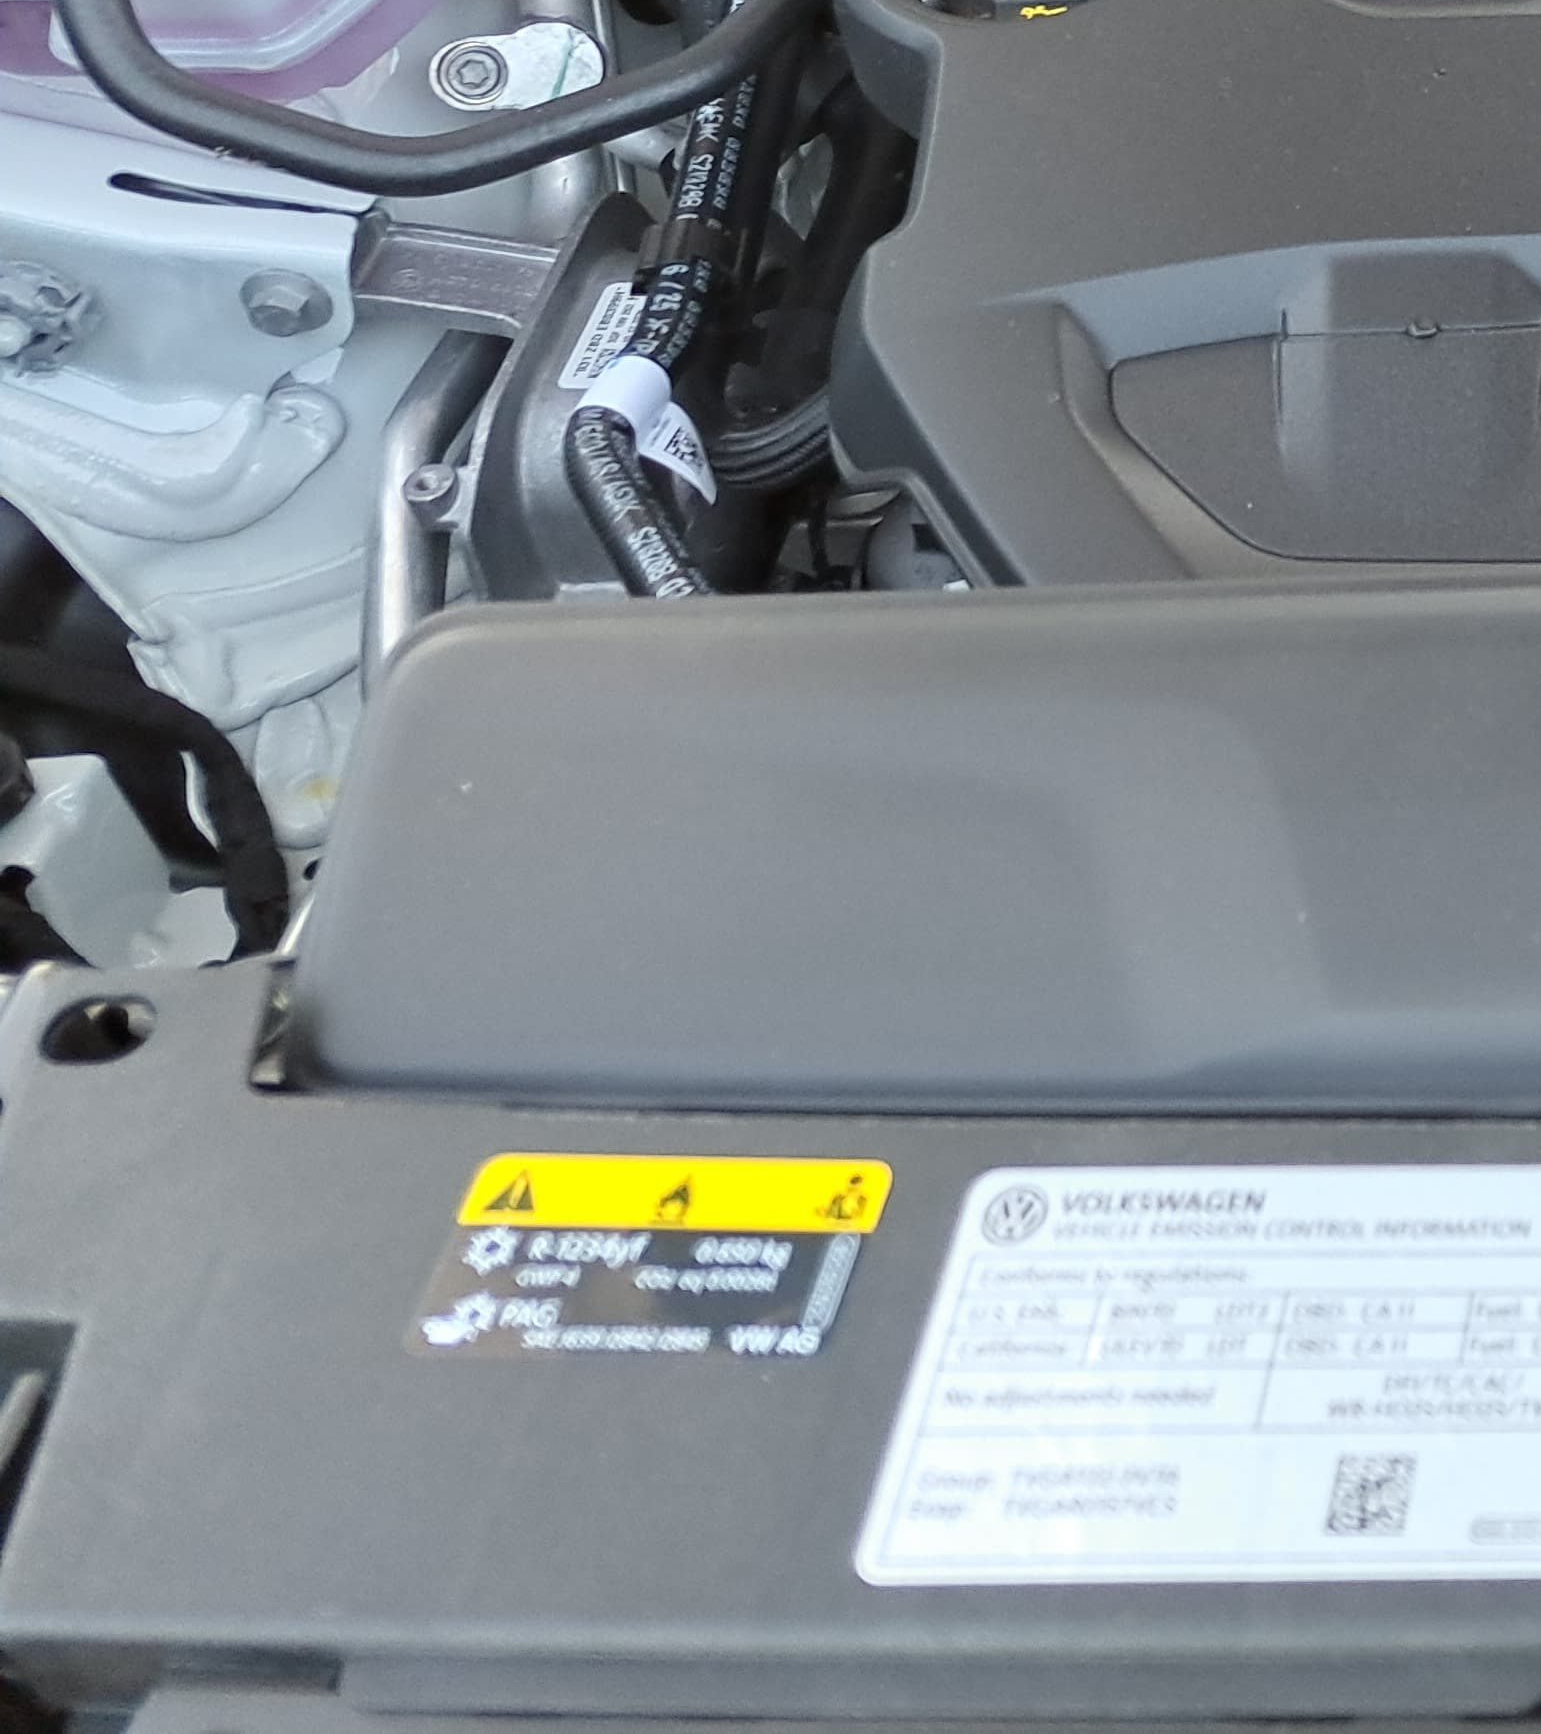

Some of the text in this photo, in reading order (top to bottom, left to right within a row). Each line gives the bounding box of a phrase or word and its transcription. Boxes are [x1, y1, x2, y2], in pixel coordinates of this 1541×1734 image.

[1062, 1189, 1267, 1214] VOLKSWAGEN
[1052, 1217, 1533, 1241] VEHICLE EMISSION CONTROL INFORMATION
[499, 1298, 563, 1328] PAG
